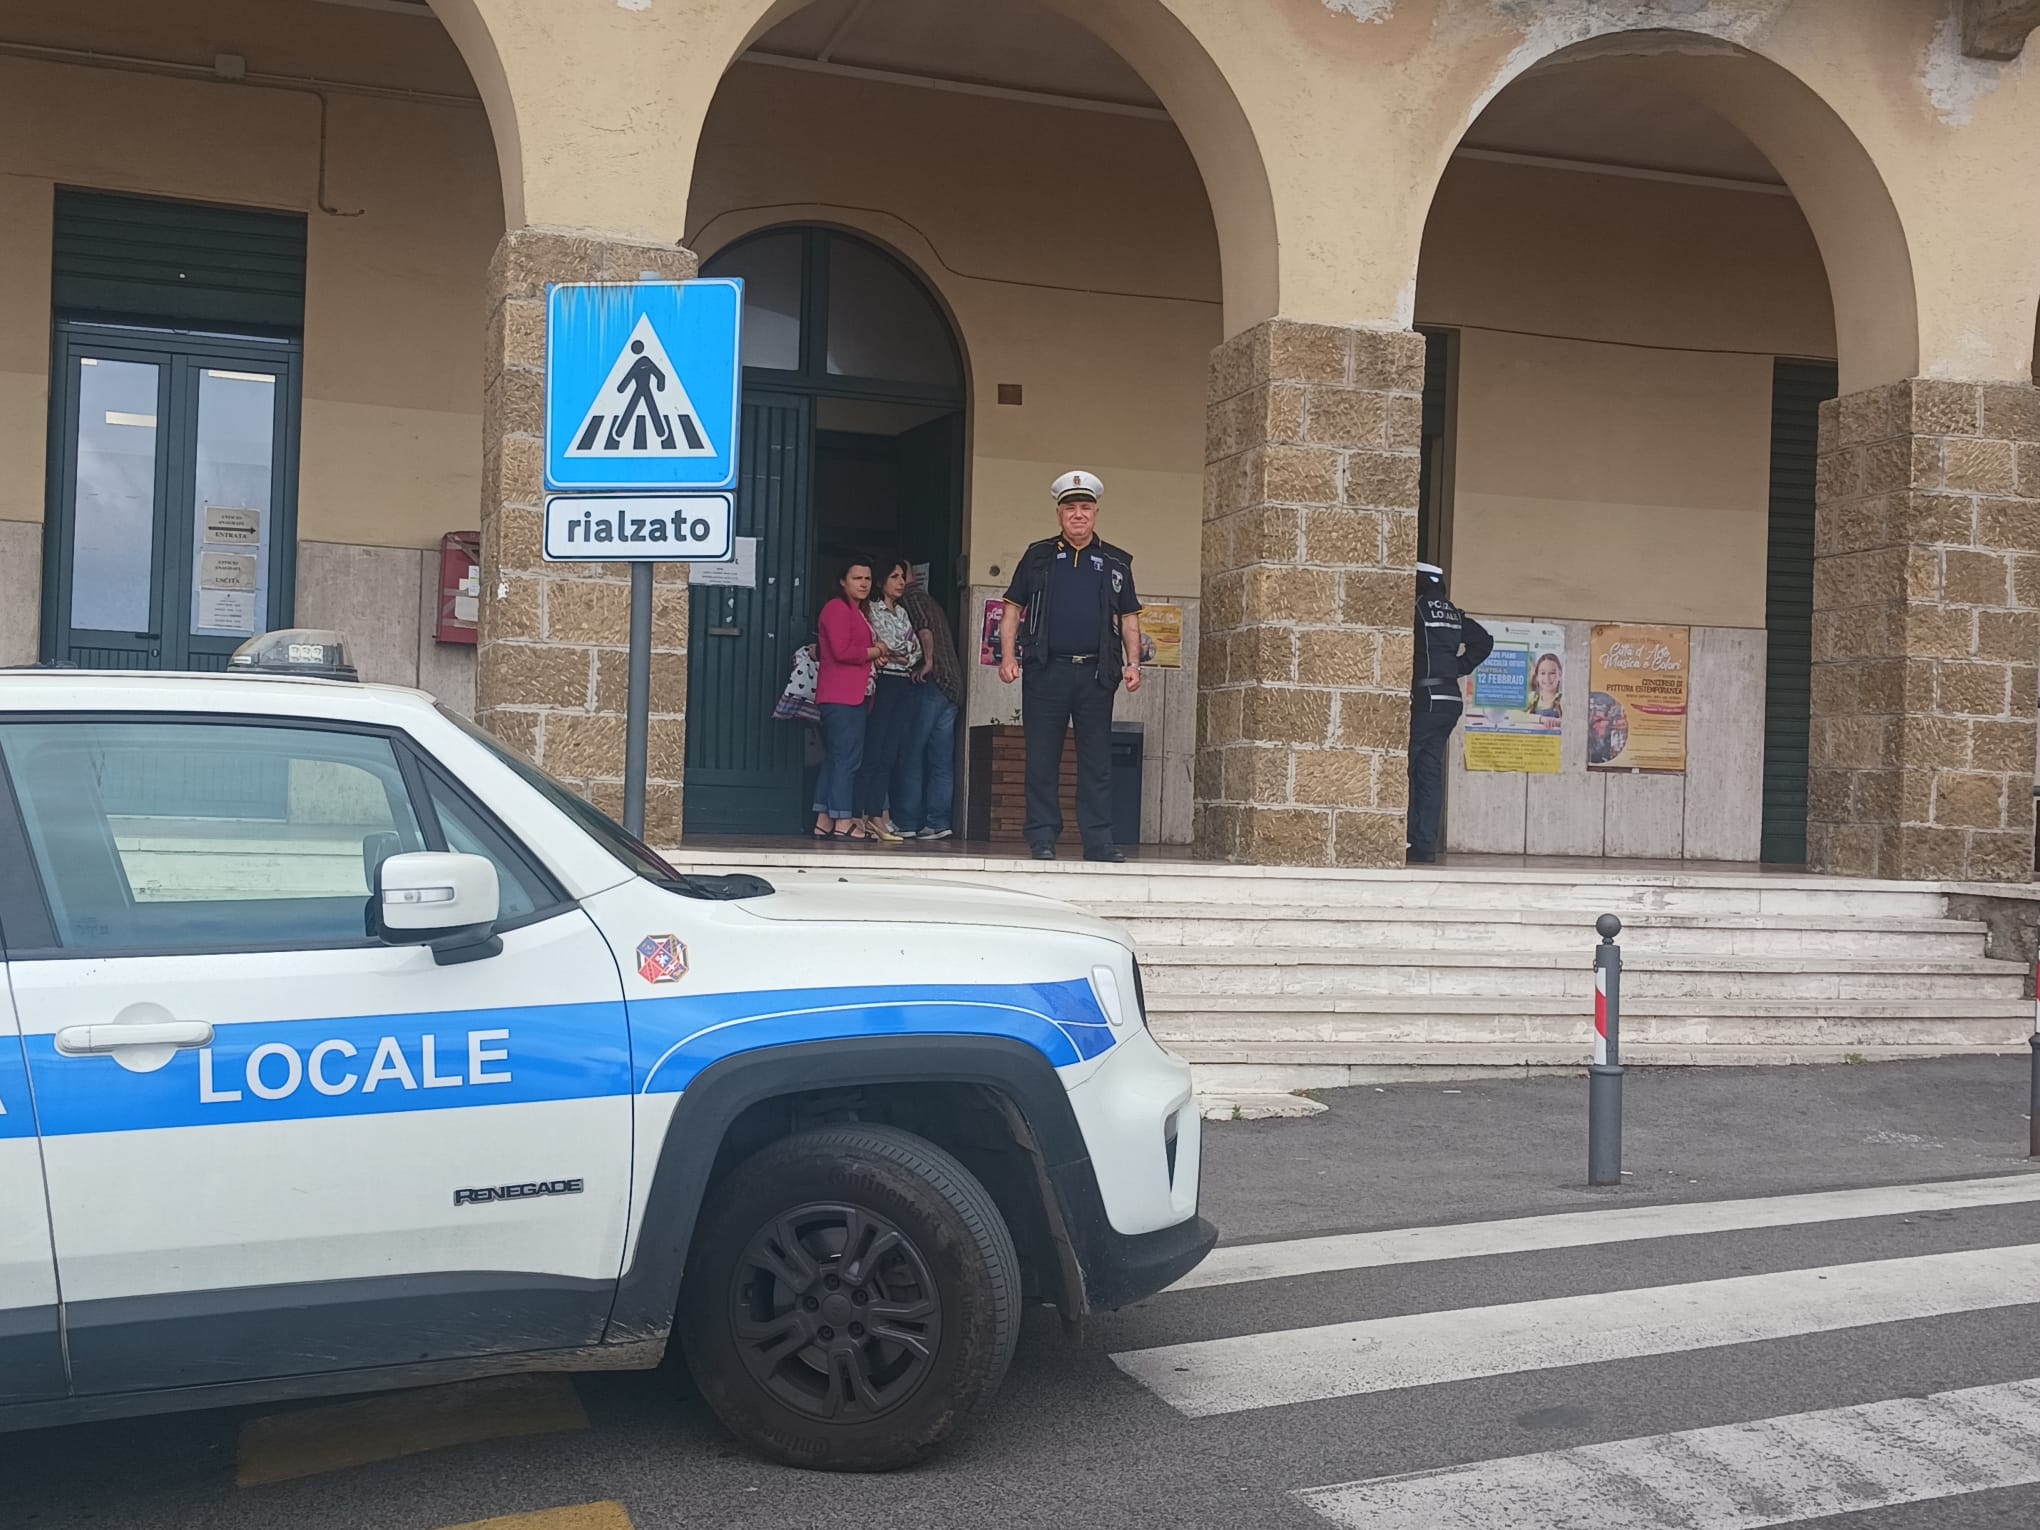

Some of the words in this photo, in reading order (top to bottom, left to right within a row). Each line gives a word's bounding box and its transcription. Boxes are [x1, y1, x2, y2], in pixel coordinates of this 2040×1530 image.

[567, 509, 711, 542] rialzato
[215, 531, 247, 539] ENTRATA
[1599, 653, 1640, 669] Musica
[1652, 656, 1682, 671] Colori
[1478, 673, 1486, 683] 12
[1488, 674, 1524, 685] FEBBRAIO
[1642, 678, 1675, 687] CONCORSO
[1606, 683, 1633, 692] PITTURA
[200, 1027, 513, 1104] LOCALE
[454, 1178, 584, 1206] RENEGADE
